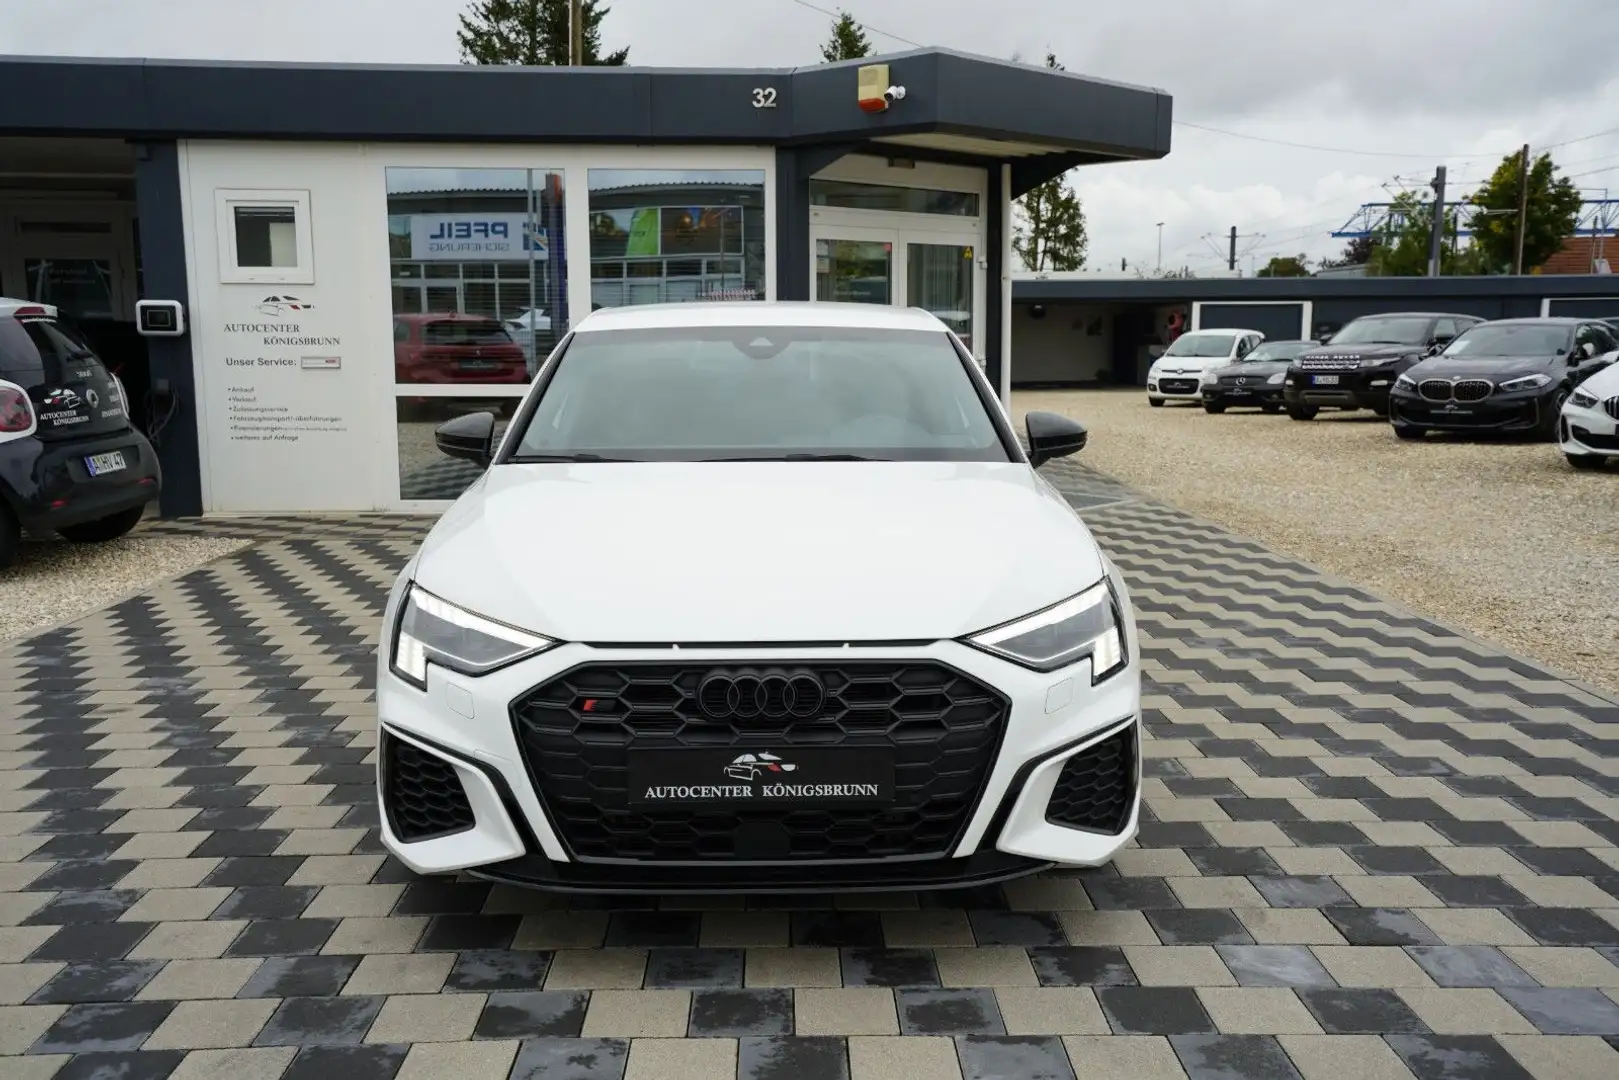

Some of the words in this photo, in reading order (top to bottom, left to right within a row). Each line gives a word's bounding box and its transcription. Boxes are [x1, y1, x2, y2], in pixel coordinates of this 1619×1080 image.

[752, 87, 777, 108] 32
[223, 323, 300, 333] AUTOCENTER
[263, 336, 341, 346] KÖNIGSBRUNN
[225, 357, 255, 366] Unser
[257, 357, 297, 367] Service:
[40, 409, 77, 420] AUTOCENTER
[644, 785, 753, 799] AUTOCENTER
[762, 782, 879, 798] KÖNIGSBRUNN
